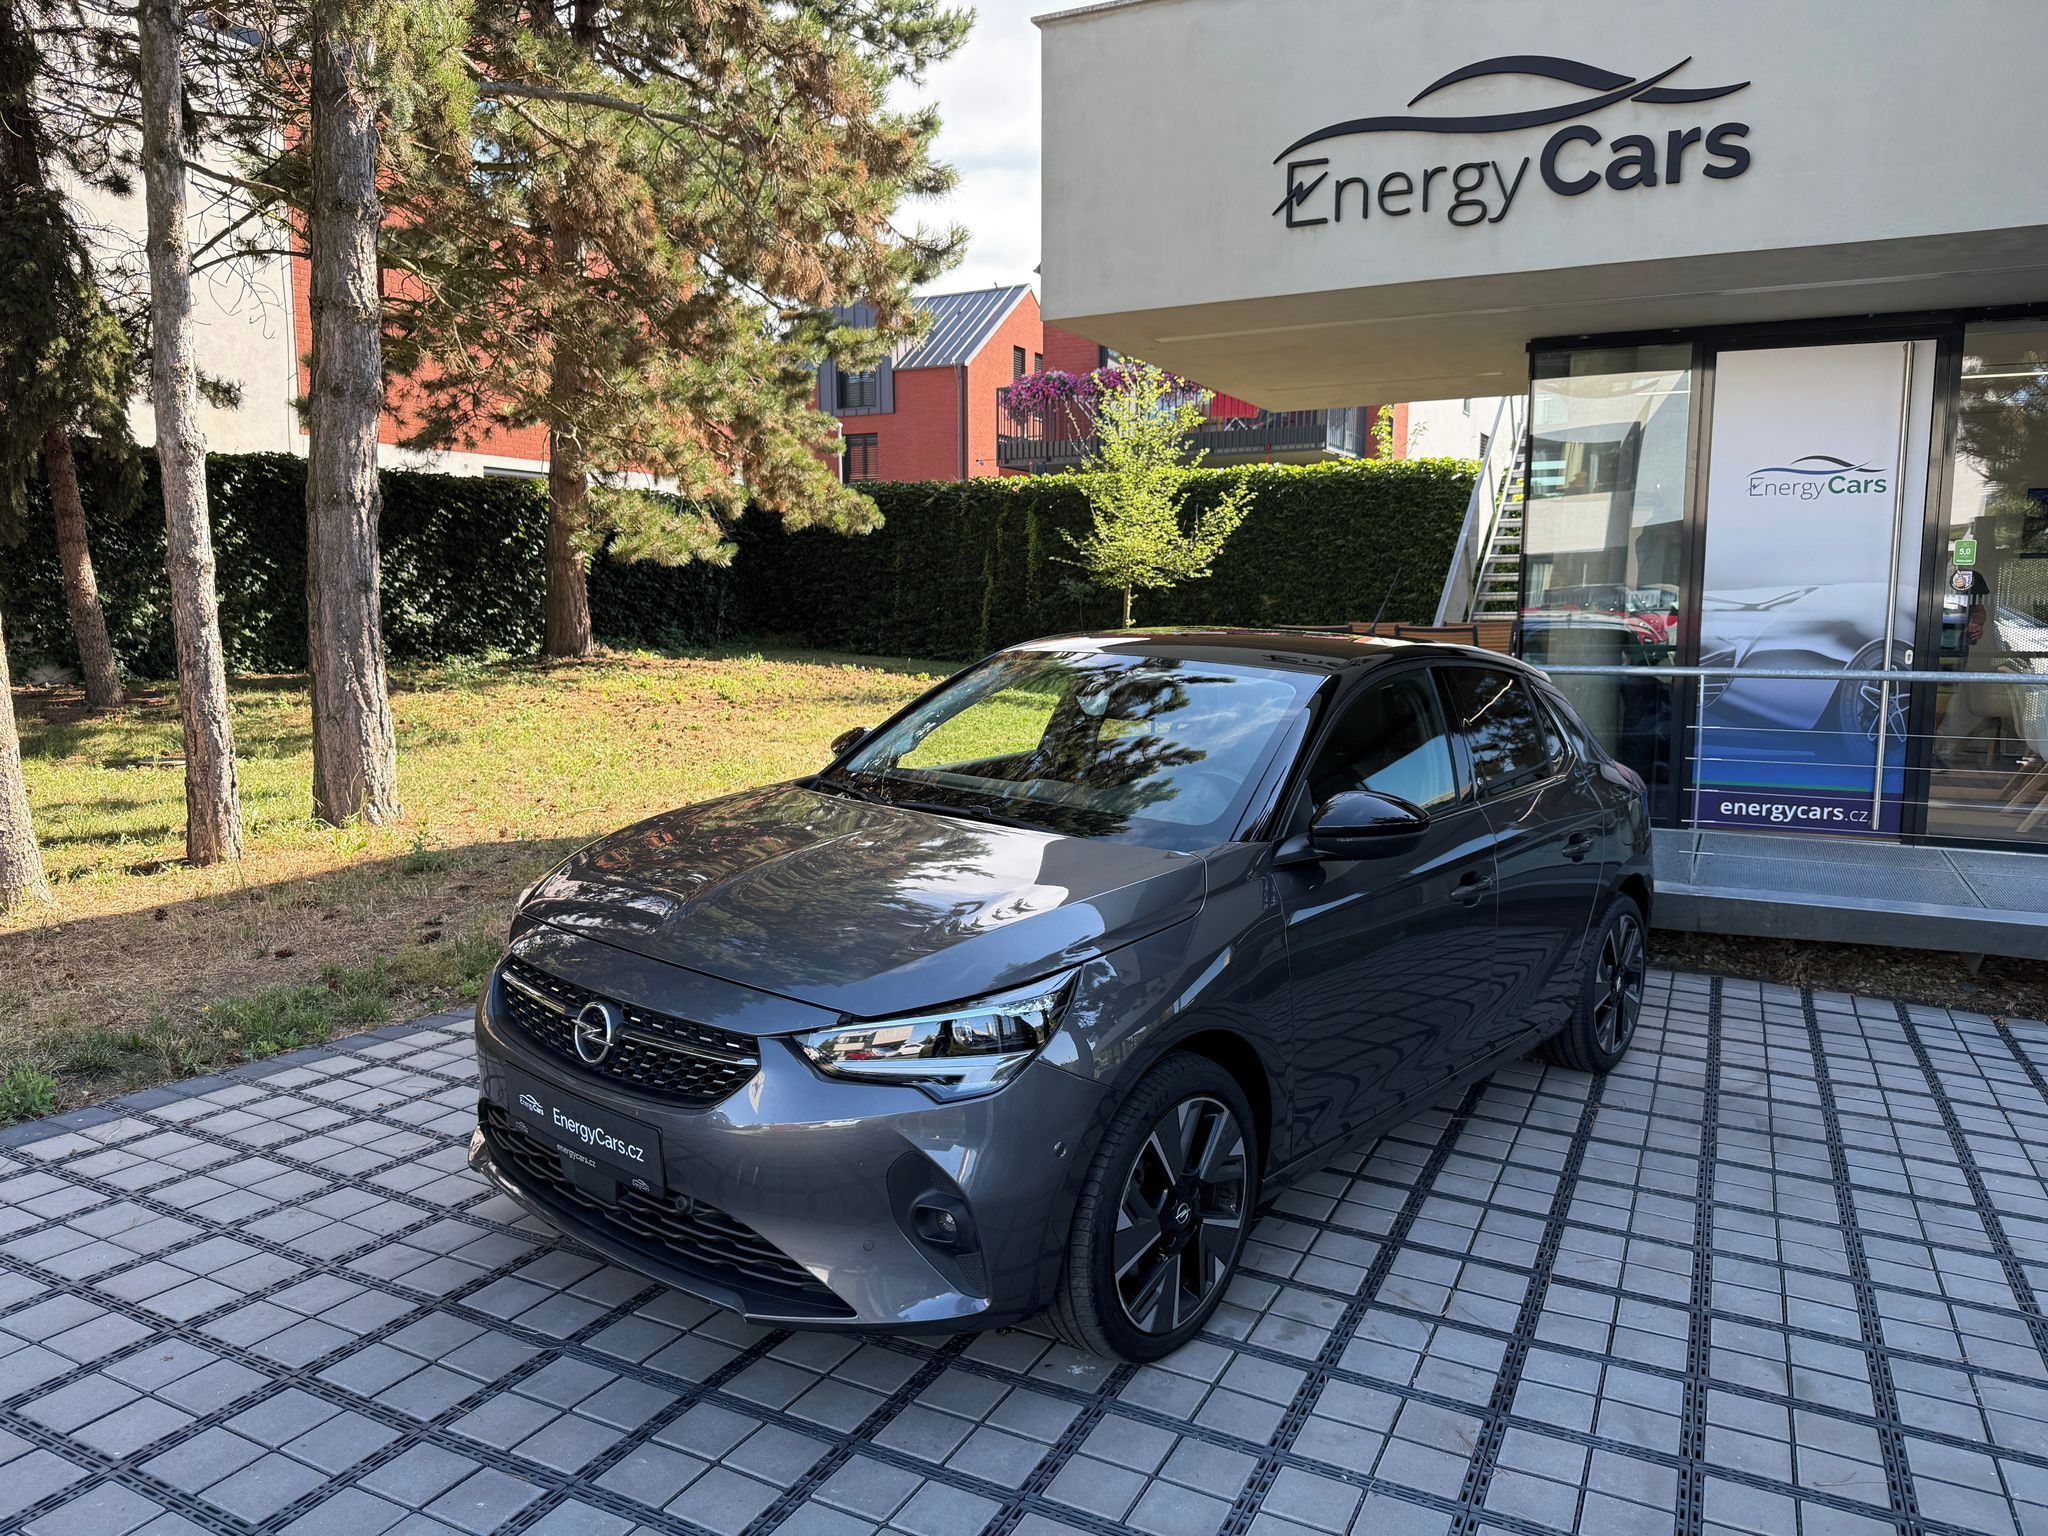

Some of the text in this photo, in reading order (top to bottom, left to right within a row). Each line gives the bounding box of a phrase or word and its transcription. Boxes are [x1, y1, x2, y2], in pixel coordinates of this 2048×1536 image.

[1273, 122, 1752, 228] EnergyCars
[1746, 475, 1887, 500] EnergyCars
[1720, 801, 1869, 823] energycars.cz
[552, 1107, 645, 1162] EnergyCars.cz
[556, 1143, 597, 1168] energycars.cz
